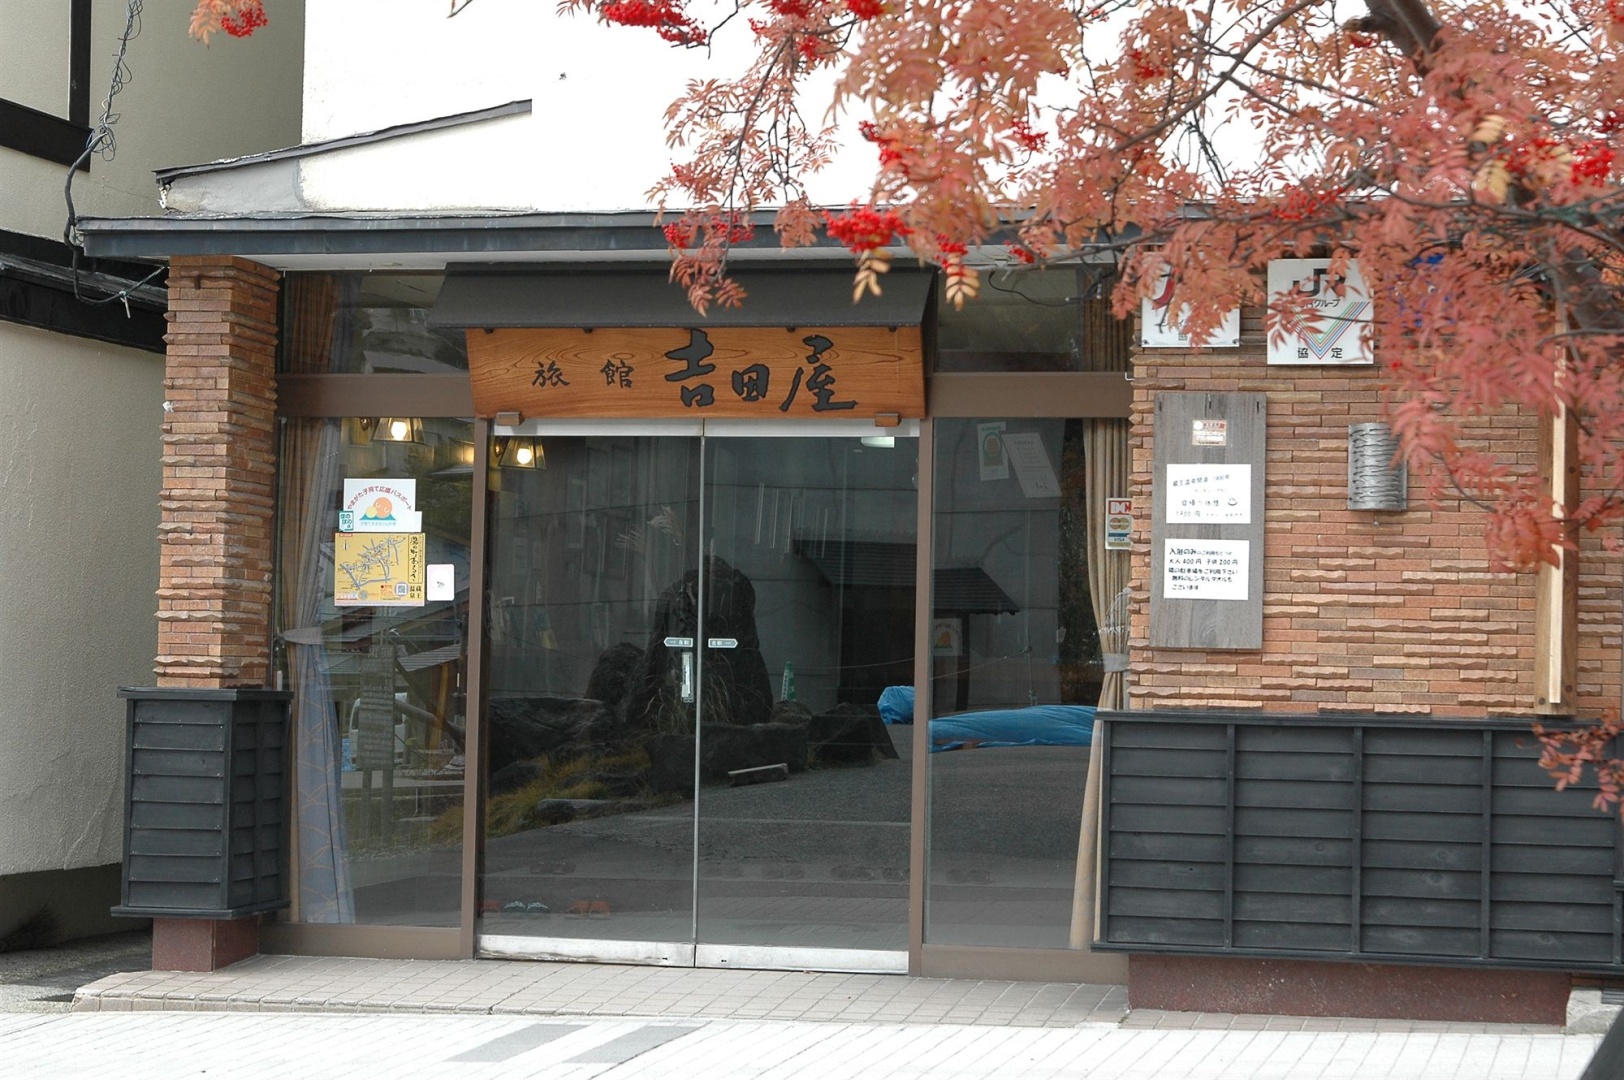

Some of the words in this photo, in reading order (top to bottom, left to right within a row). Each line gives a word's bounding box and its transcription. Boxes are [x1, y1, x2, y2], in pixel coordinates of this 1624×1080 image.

[532, 358, 635, 389] 旅館
[664, 327, 858, 412] 吉田屋
